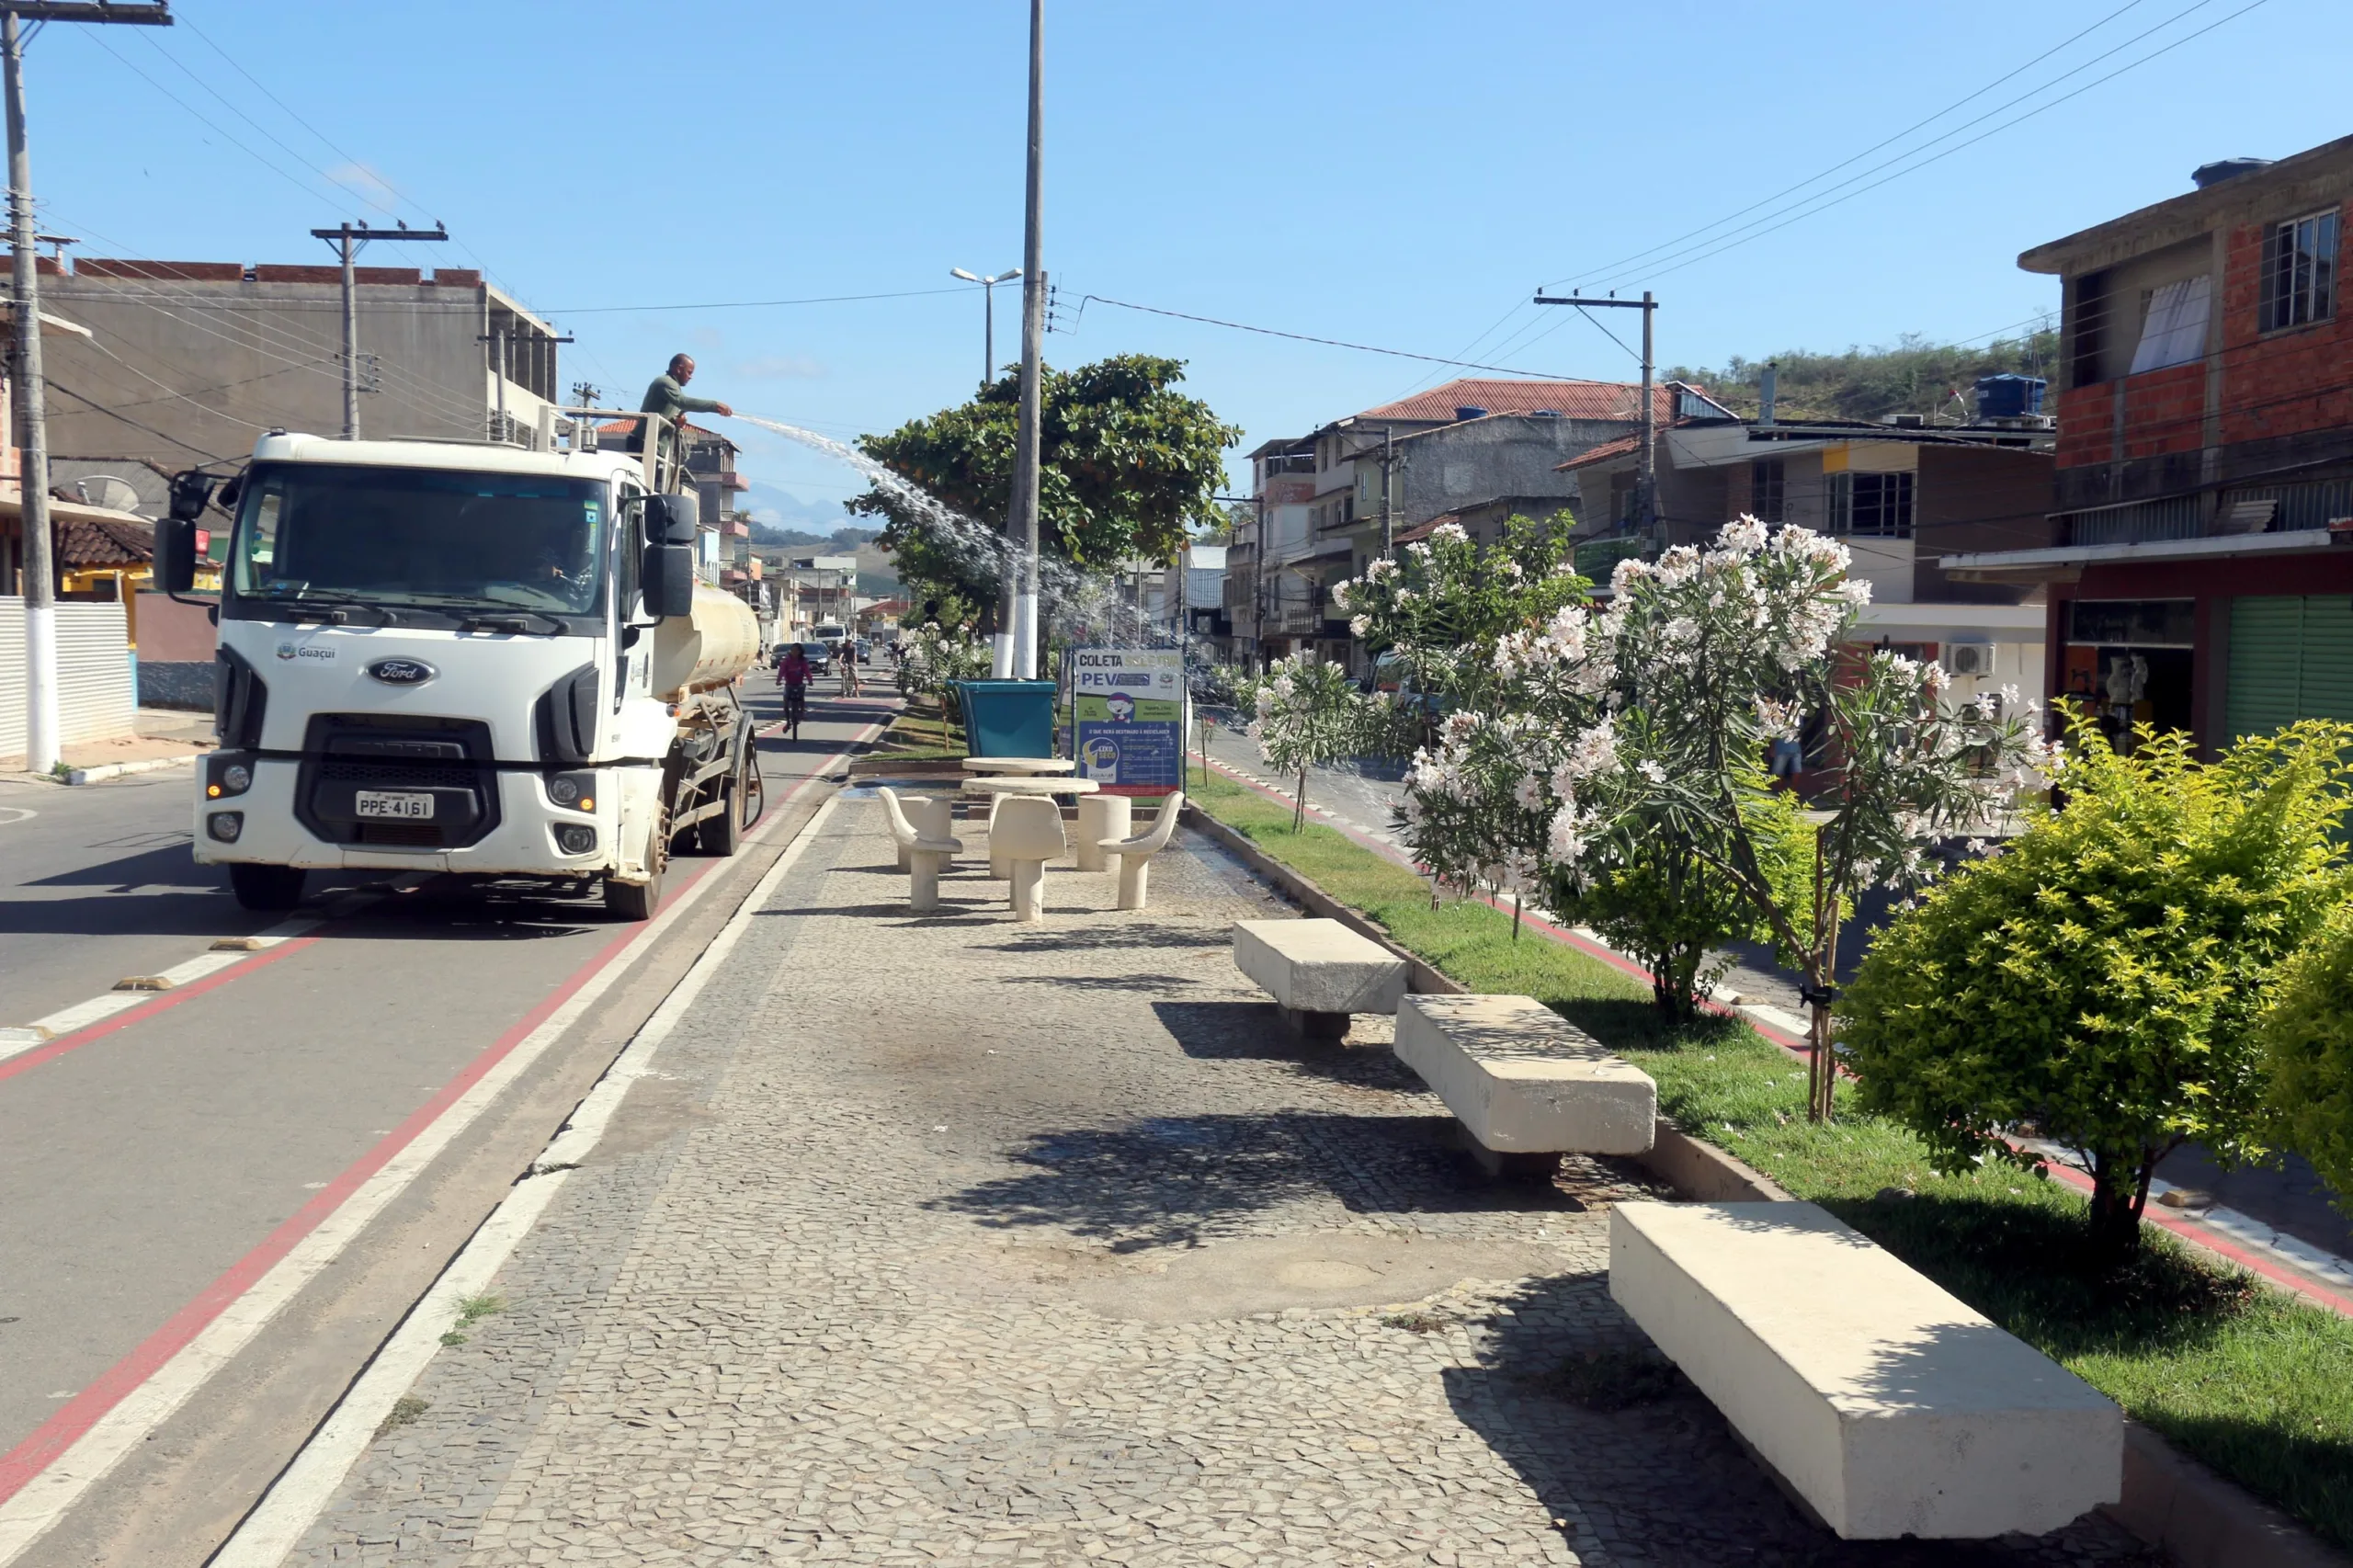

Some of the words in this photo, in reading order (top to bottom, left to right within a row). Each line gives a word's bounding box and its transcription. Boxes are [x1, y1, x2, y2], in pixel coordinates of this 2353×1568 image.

[299, 647, 335, 661] Guaçuí
[1079, 654, 1122, 666] COLETA
[380, 662, 418, 679] Ford
[1082, 673, 1118, 686] PEV
